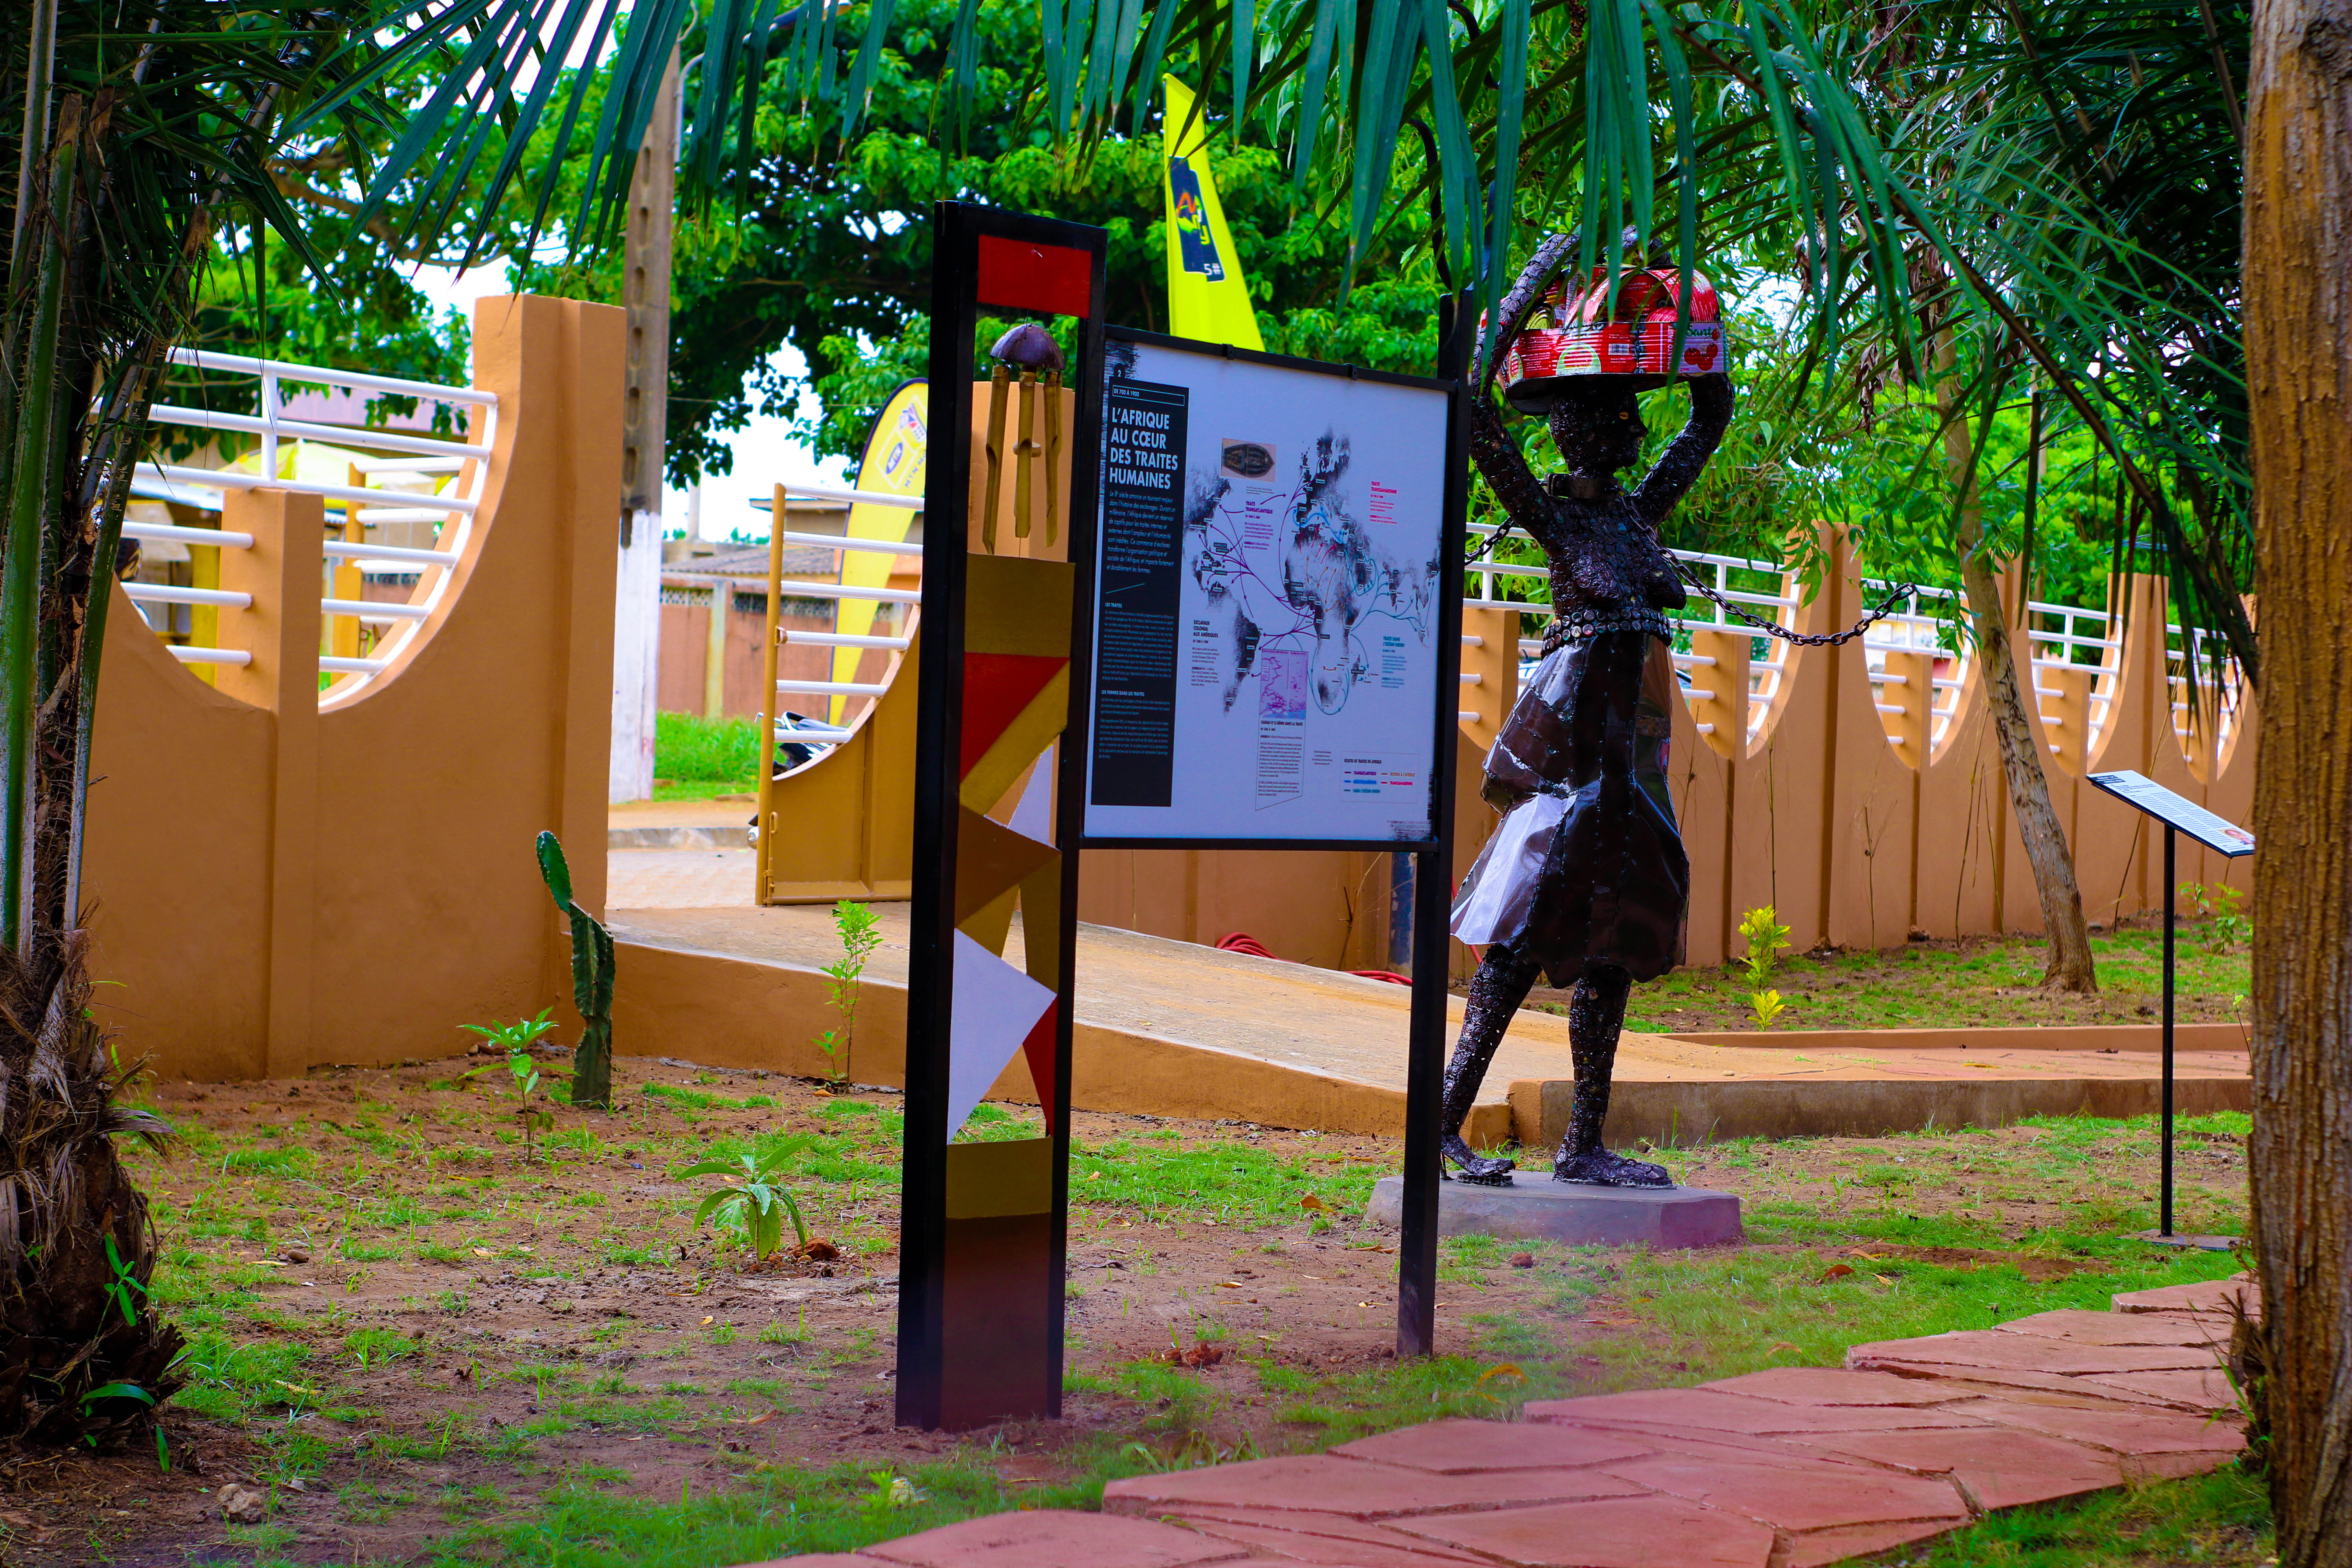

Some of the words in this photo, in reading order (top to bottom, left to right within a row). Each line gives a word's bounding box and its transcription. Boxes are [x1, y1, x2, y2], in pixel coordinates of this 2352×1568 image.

[1203, 263, 1221, 276] 5#
[1111, 428, 1128, 445] AU
[1132, 430, 1166, 449] CŒUR
[1111, 448, 1131, 465] DES
[1135, 450, 1178, 470] TRAITES
[1109, 468, 1171, 489] HUMAINES
